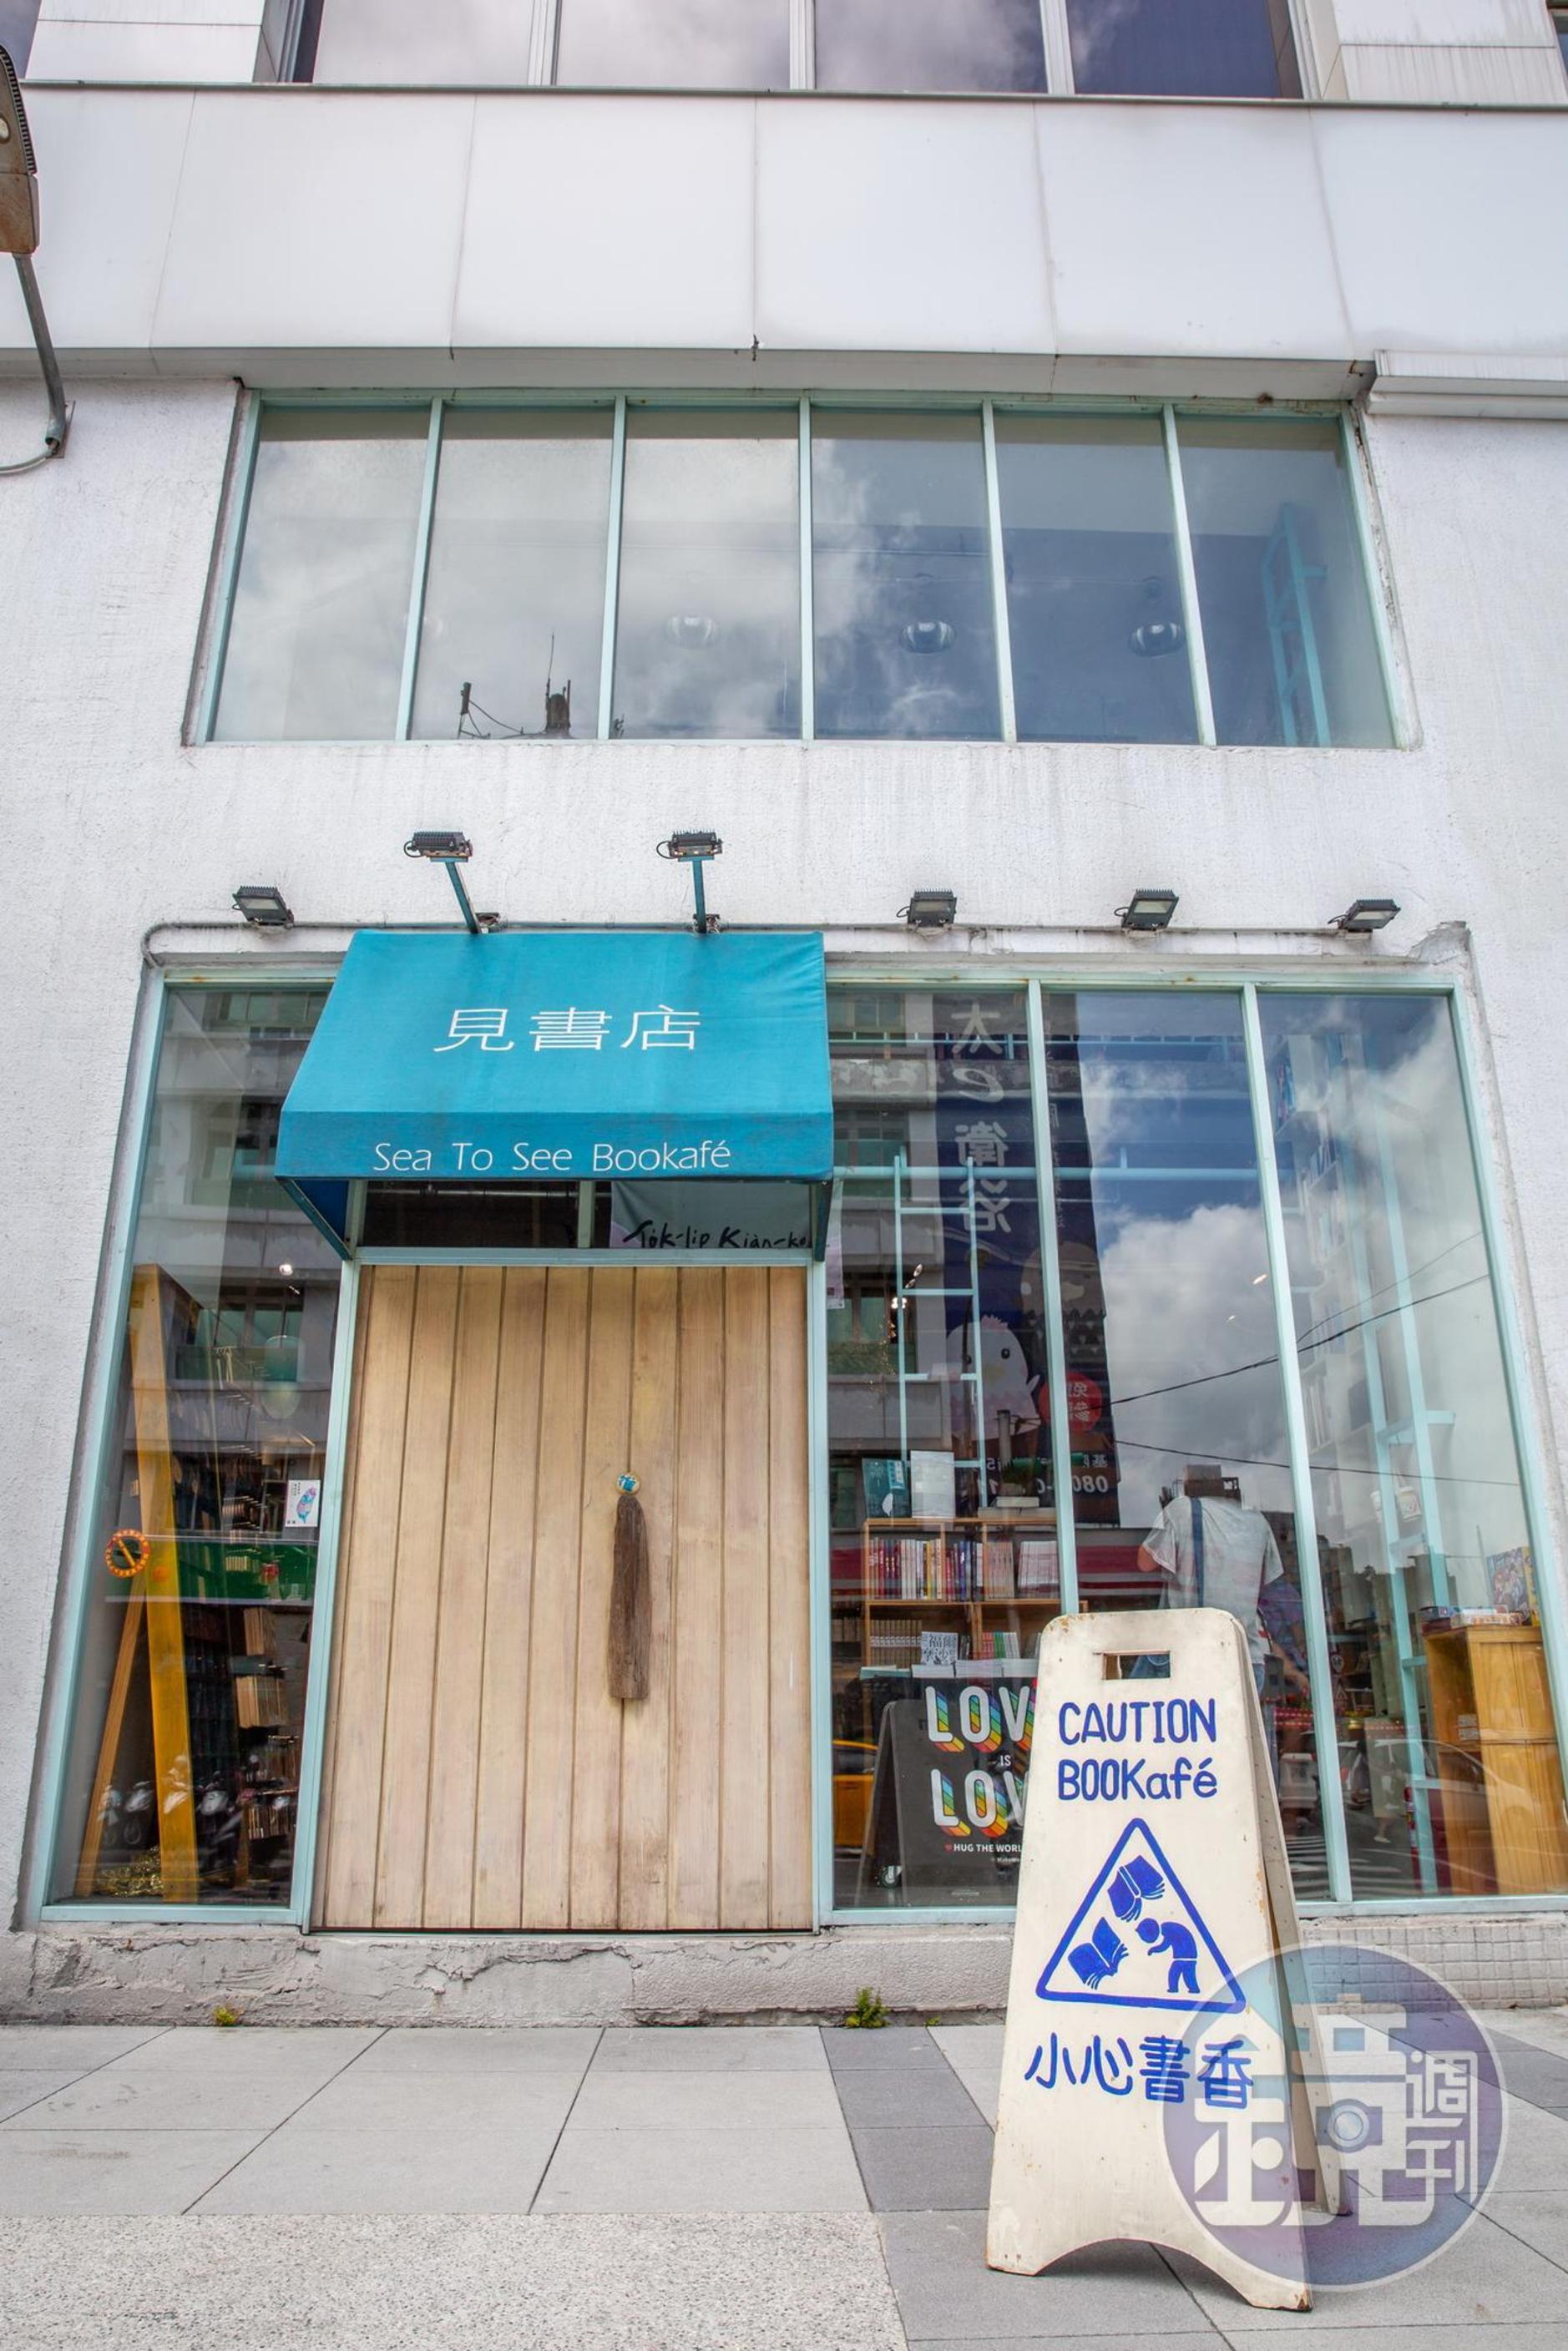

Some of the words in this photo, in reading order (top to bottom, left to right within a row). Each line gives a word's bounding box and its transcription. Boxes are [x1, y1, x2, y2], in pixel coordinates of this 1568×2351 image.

[432, 1004, 701, 1052] 見書店
[372, 1142, 432, 1171] Sea
[451, 1142, 493, 1170] To
[512, 1142, 573, 1171] See
[592, 1139, 731, 1171] Bookafé
[925, 1686, 1034, 1750] LOV
[1059, 1697, 1217, 1746] CAUTION
[999, 1754, 1012, 1767] IS
[1058, 1757, 1218, 1801] BOOKafé
[931, 1768, 1029, 1833] LOV
[953, 1843, 974, 1853] HUG
[976, 1843, 994, 1853] THE
[996, 1843, 1023, 1854] WORL
[1024, 2031, 1254, 2110] 小心書香
